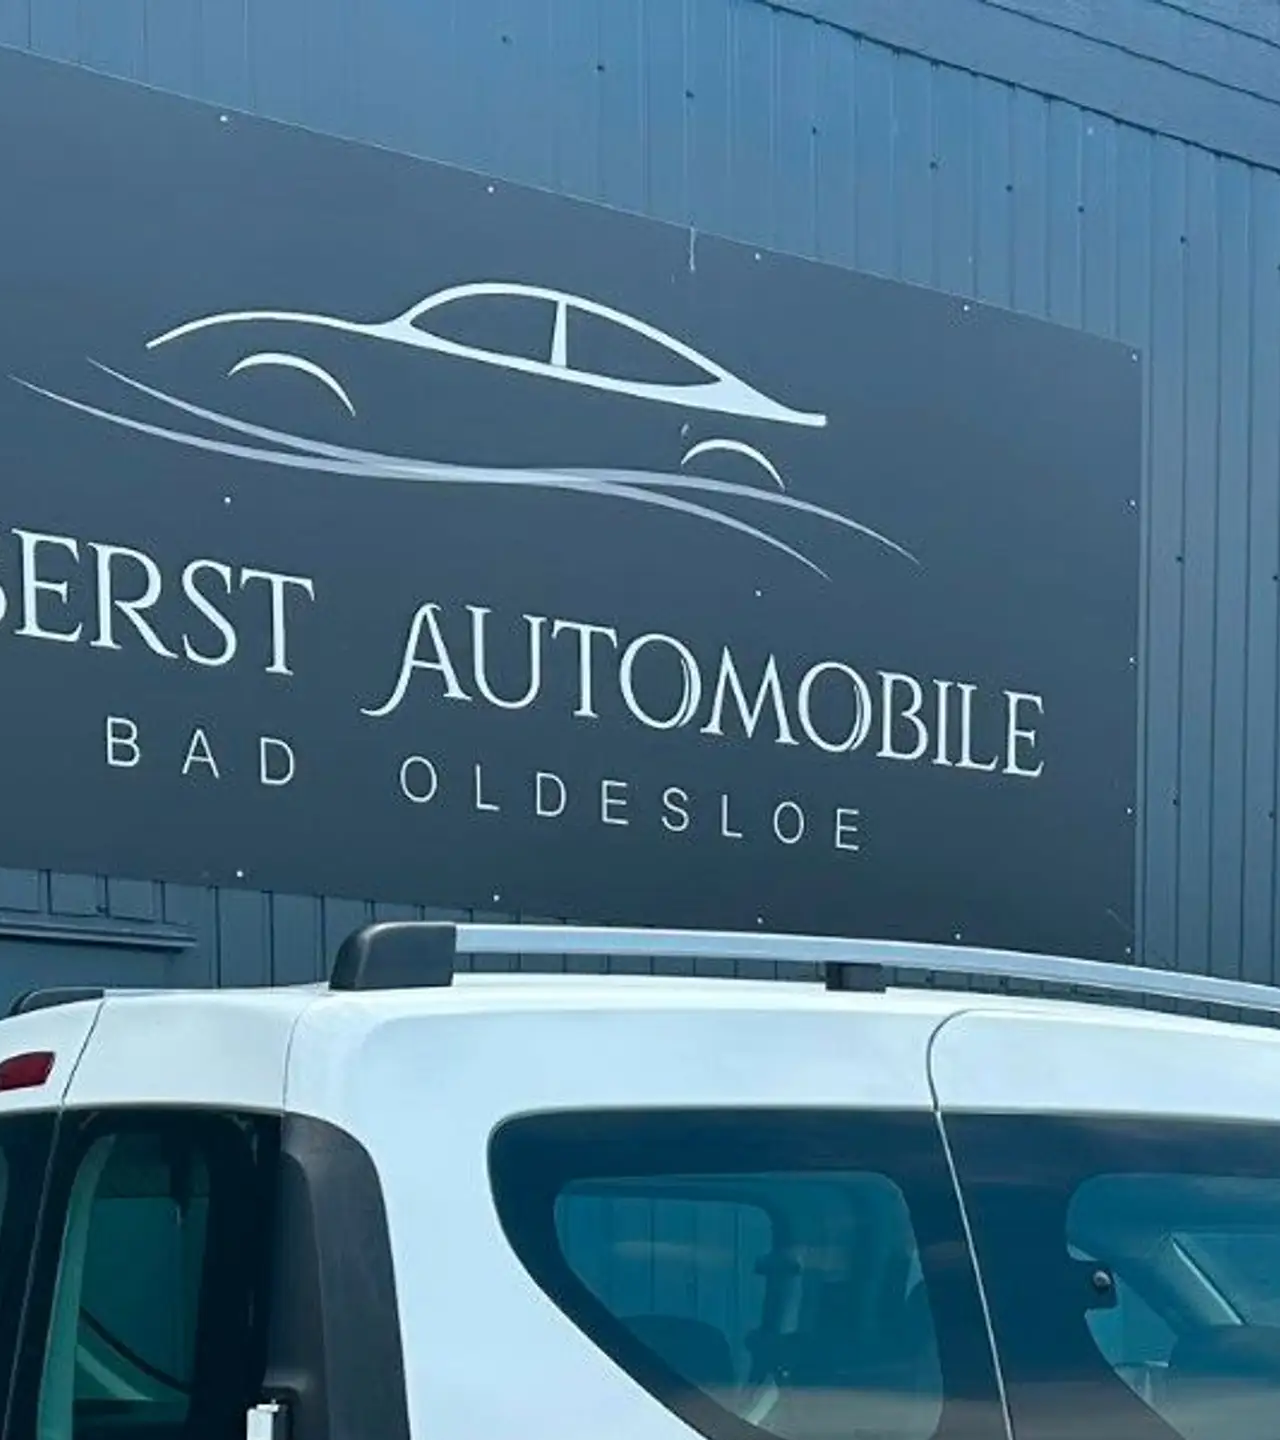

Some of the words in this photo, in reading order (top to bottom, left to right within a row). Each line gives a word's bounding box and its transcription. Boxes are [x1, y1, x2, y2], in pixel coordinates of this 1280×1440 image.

[359, 602, 1046, 779] AUTOMOBILE
[106, 715, 296, 787] BAD
[400, 754, 860, 852] OLDESLOE
